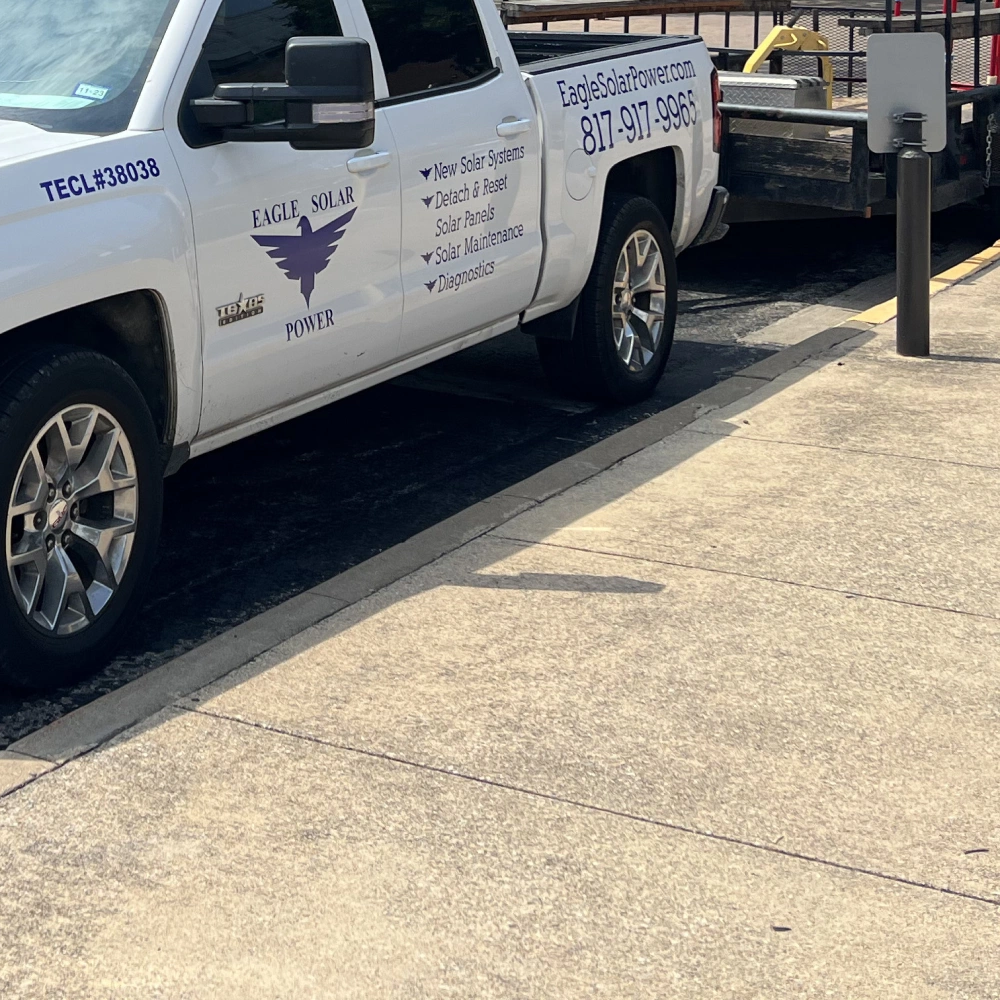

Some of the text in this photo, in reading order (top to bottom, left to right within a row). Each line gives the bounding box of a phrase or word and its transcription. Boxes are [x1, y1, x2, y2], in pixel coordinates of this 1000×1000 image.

[556, 59, 697, 109] EagleSolarPower.com
[580, 89, 698, 156] 817-917-9965
[39, 157, 160, 202] TECL#38038
[434, 145, 525, 182] New Solar Systems
[251, 185, 356, 229] EAGLE SOLAR
[434, 175, 508, 210] Detach & Reset
[434, 203, 496, 238] Solar Panels
[434, 223, 524, 266] Solar Maintenance
[437, 260, 496, 294] Diagnostics
[215, 293, 265, 318] TEXAS
[285, 309, 335, 342] POWER
